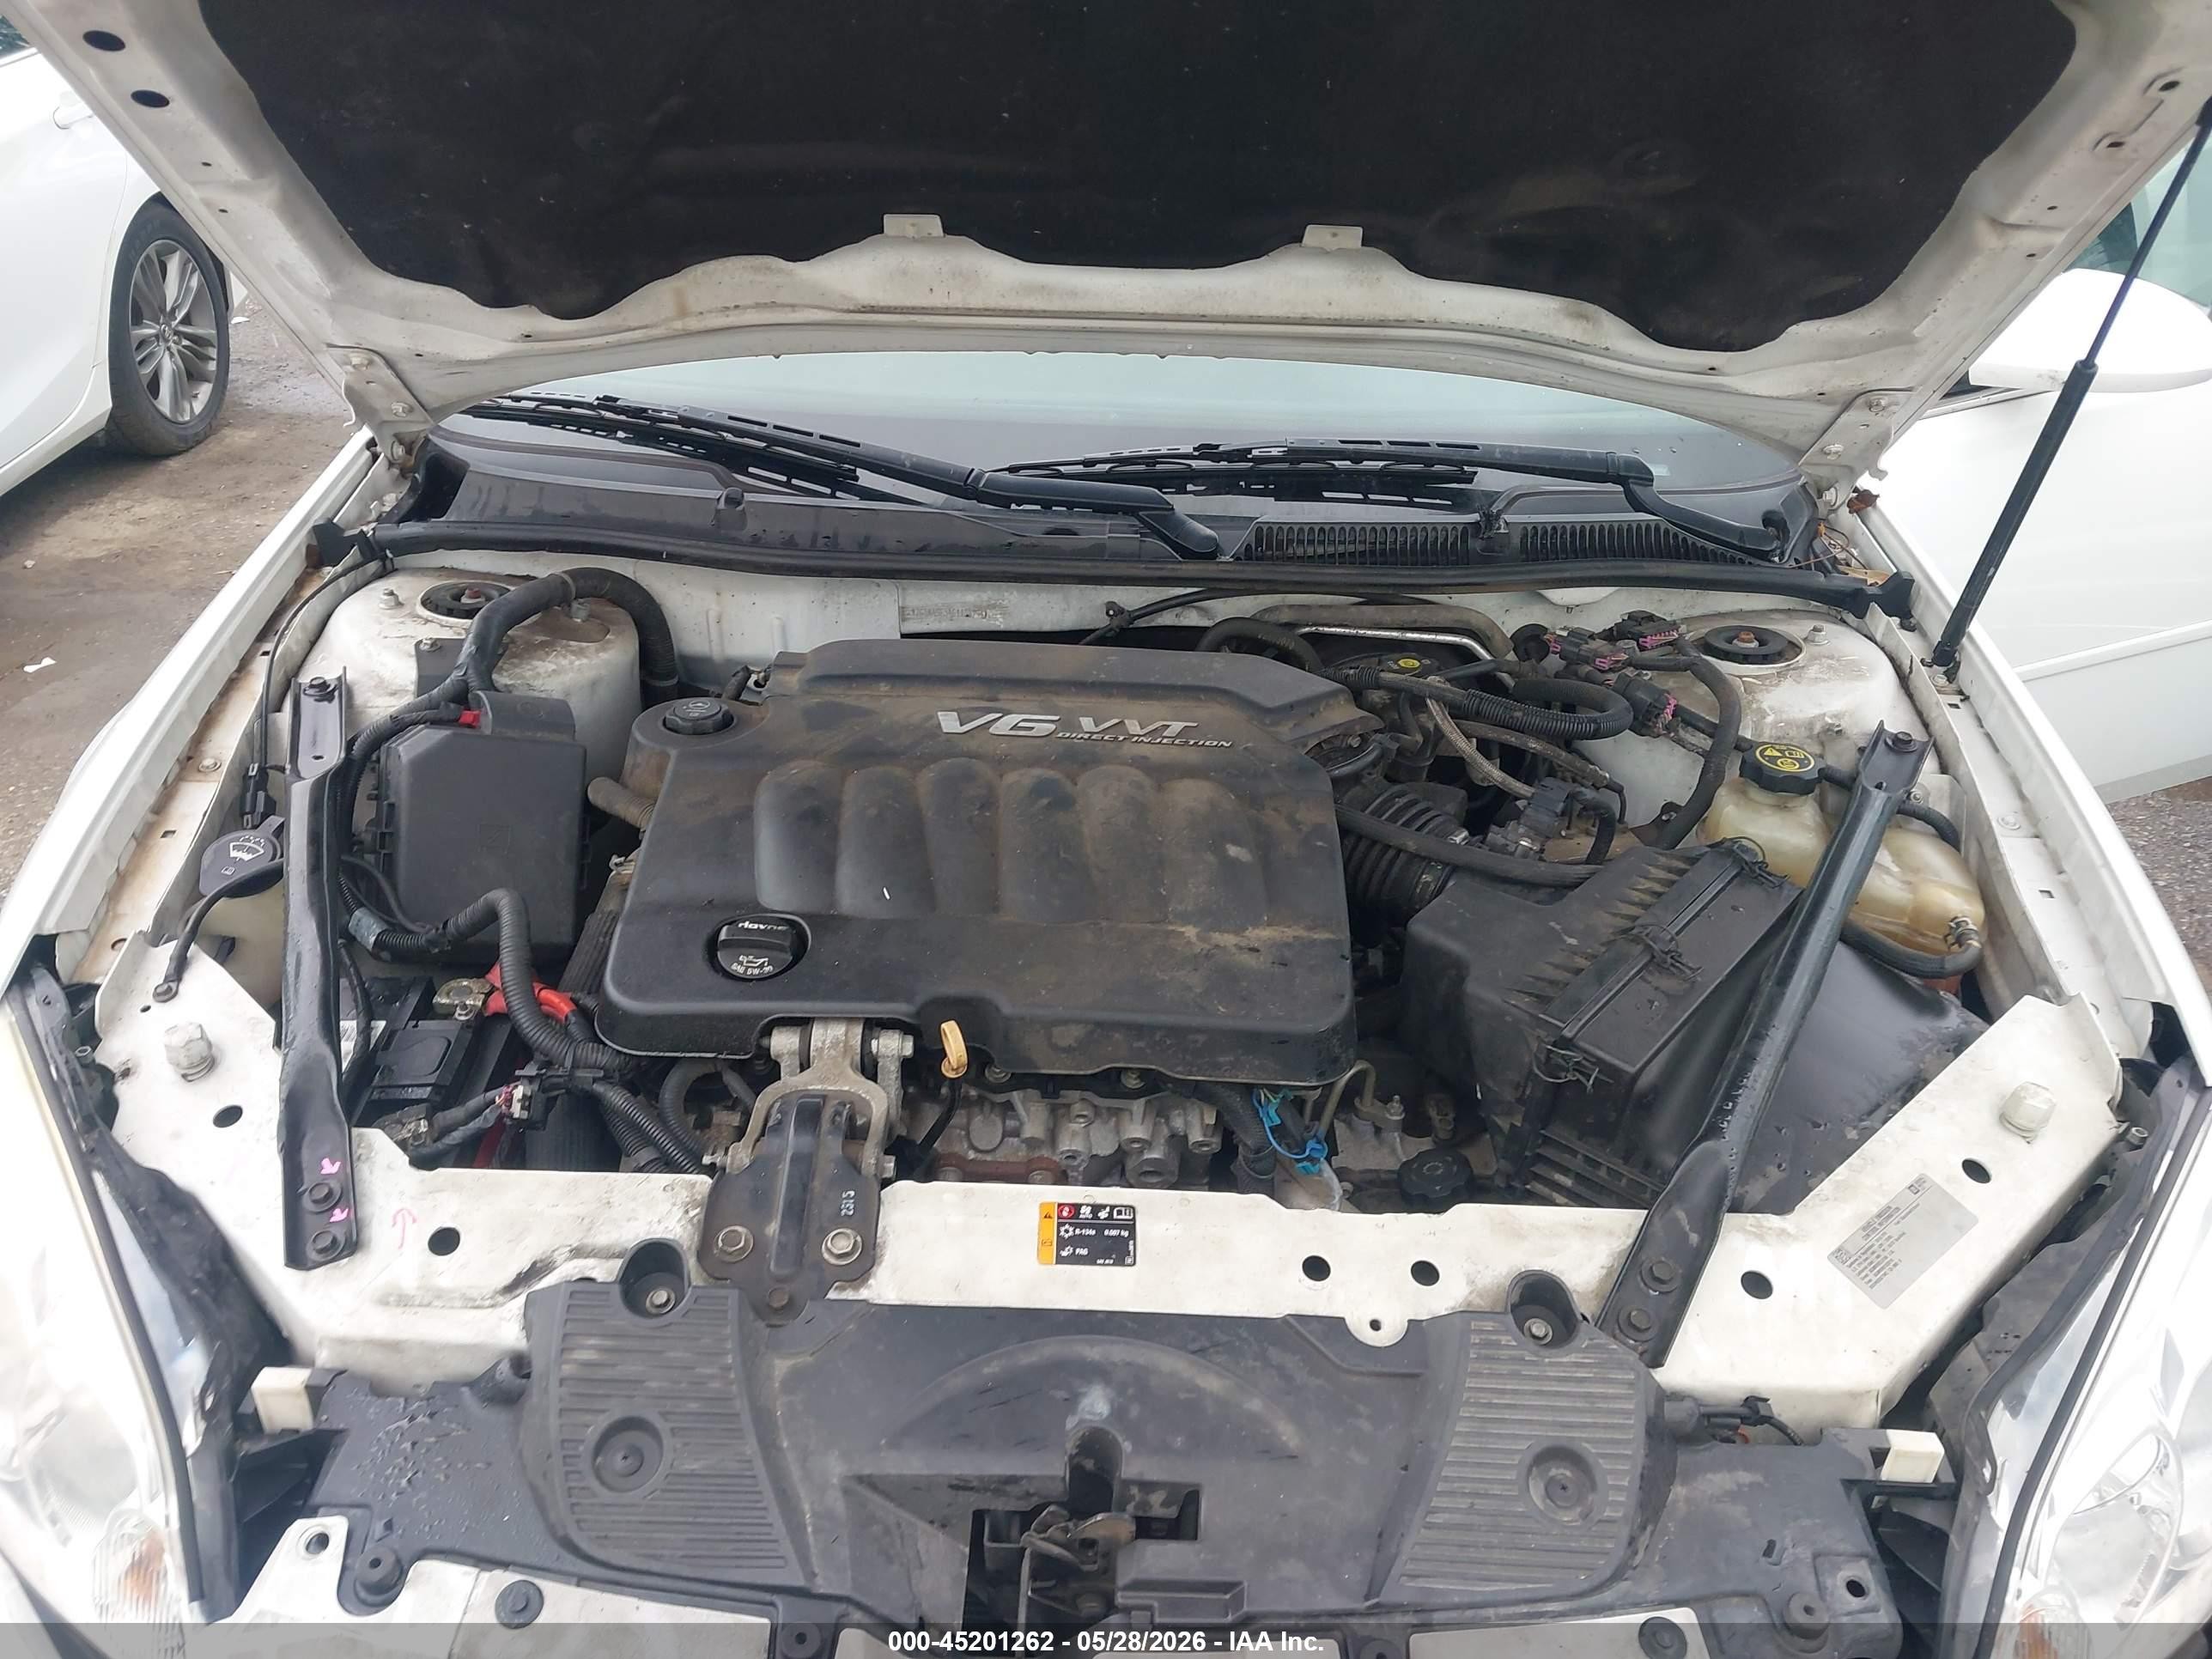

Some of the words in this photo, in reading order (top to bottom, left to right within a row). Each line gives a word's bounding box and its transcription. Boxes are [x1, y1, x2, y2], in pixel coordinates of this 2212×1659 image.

[936, 711, 1061, 737] V6
[1078, 716, 1199, 738] VVT
[1056, 732, 1130, 743] DIRECT
[1131, 735, 1233, 747] INJECTION
